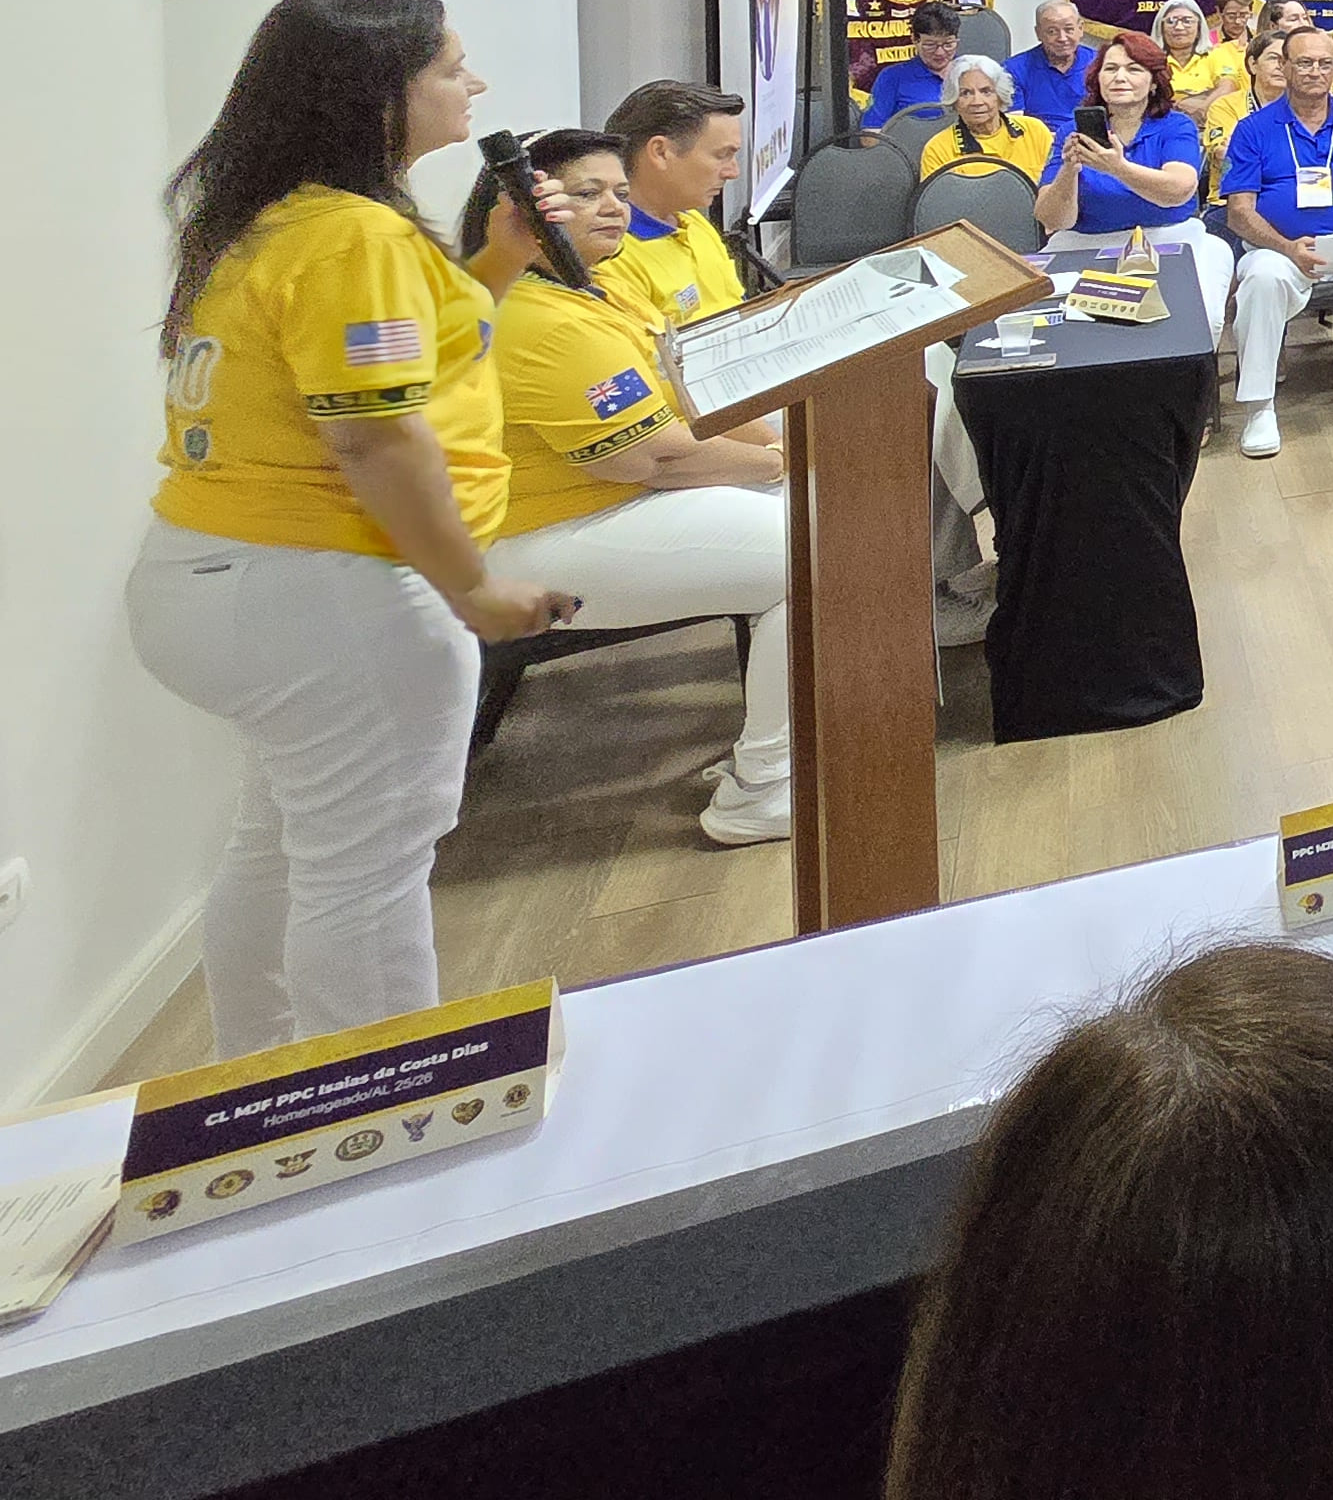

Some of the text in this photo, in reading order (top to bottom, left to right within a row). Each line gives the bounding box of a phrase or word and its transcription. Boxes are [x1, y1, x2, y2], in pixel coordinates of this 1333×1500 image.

[1136, 1, 1165, 13] BRAS
[875, 45, 918, 64] DISTRIT
[1292, 845, 1314, 860] PPC
[204, 1110, 230, 1127] CL
[233, 1098, 273, 1119] MJF
[275, 1086, 315, 1108] PPC
[373, 1066, 396, 1080] da
[399, 1052, 449, 1073] Costa
[451, 1041, 489, 1060] Dias
[262, 1071, 434, 1128] Homenageado/AL 25/26
